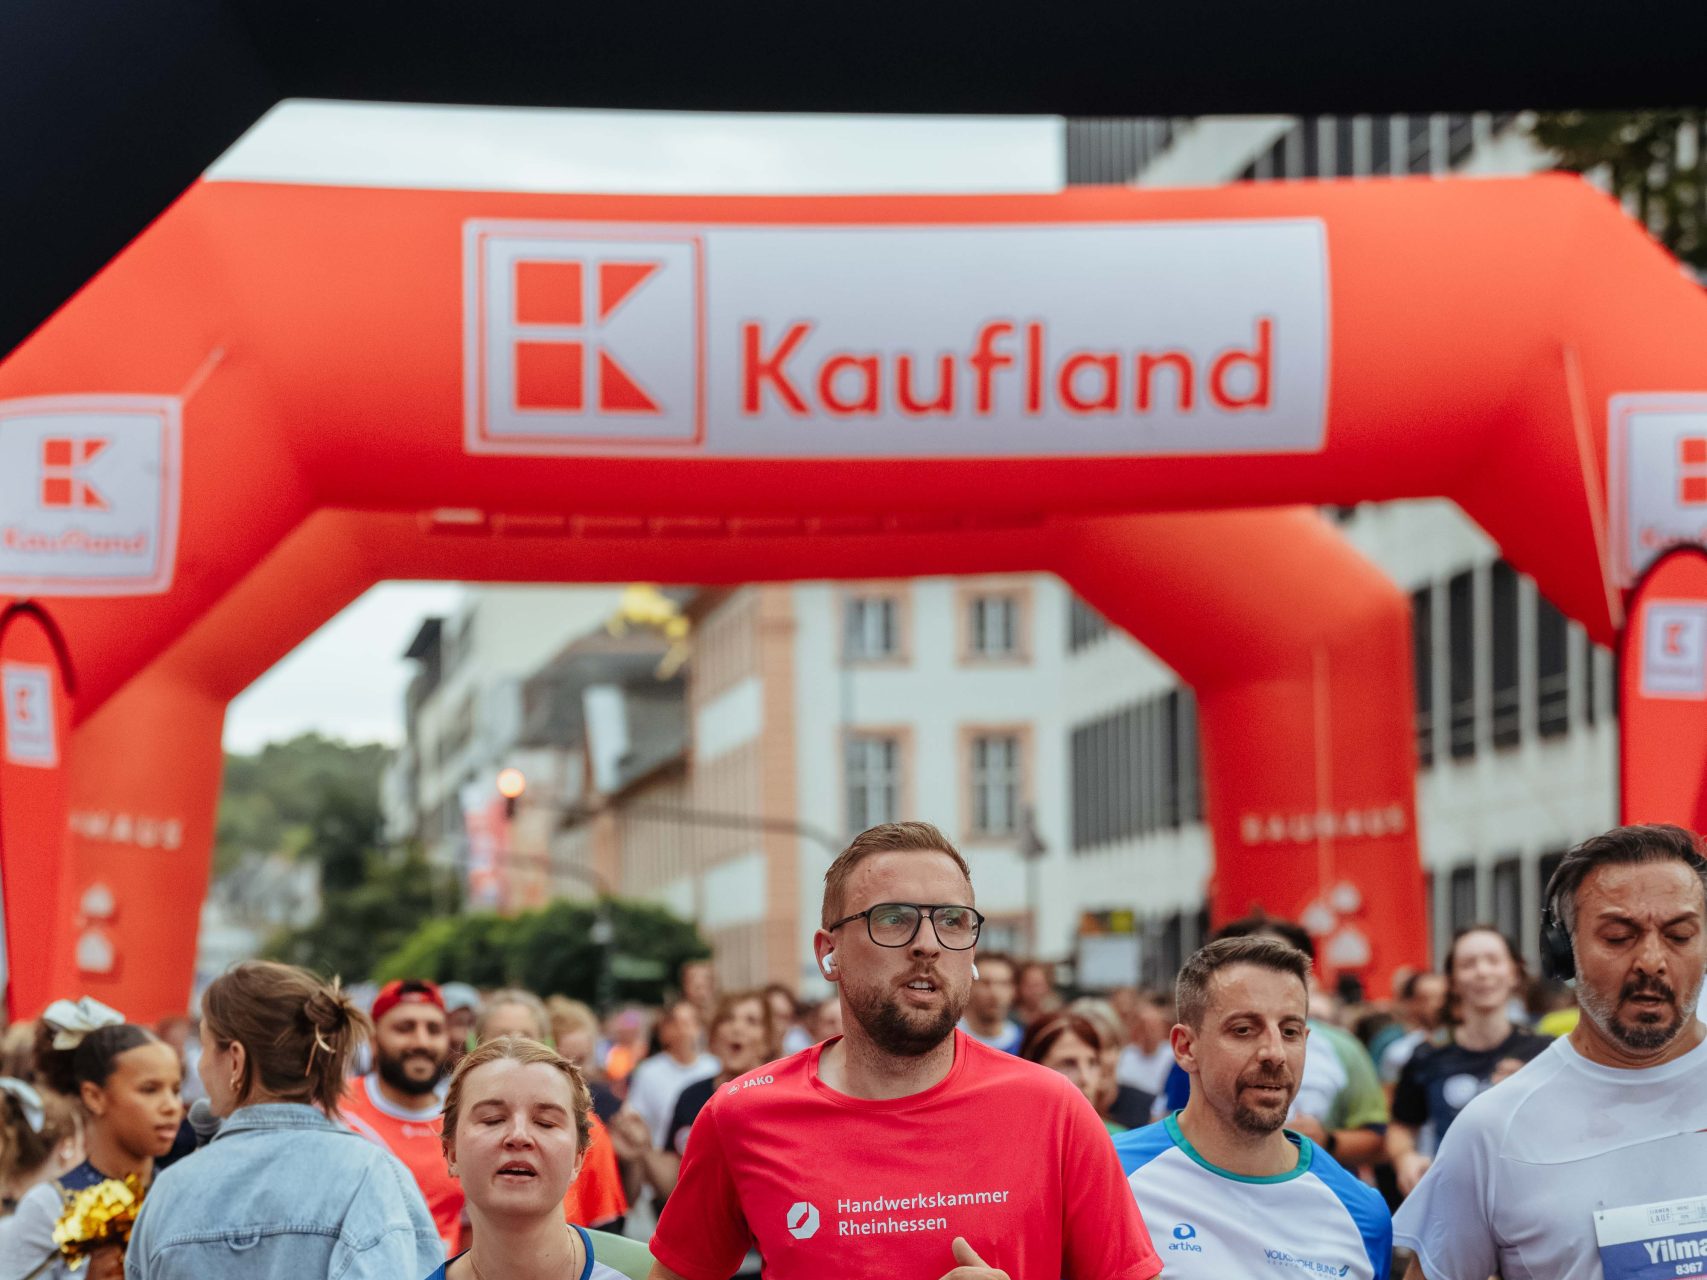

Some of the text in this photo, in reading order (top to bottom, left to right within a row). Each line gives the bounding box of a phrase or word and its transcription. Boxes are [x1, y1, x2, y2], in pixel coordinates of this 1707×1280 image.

[742, 318, 1273, 415] Kaufland
[743, 1075, 774, 1088] JAKO
[837, 1190, 1009, 1213] Handwerkskammer
[838, 1216, 947, 1236] Rheinhessen
[1168, 1241, 1202, 1252] artiva
[1264, 1248, 1315, 1270] VOLKSHL
[1316, 1262, 1338, 1276] BUND
[1675, 1262, 1703, 1275] 8367
